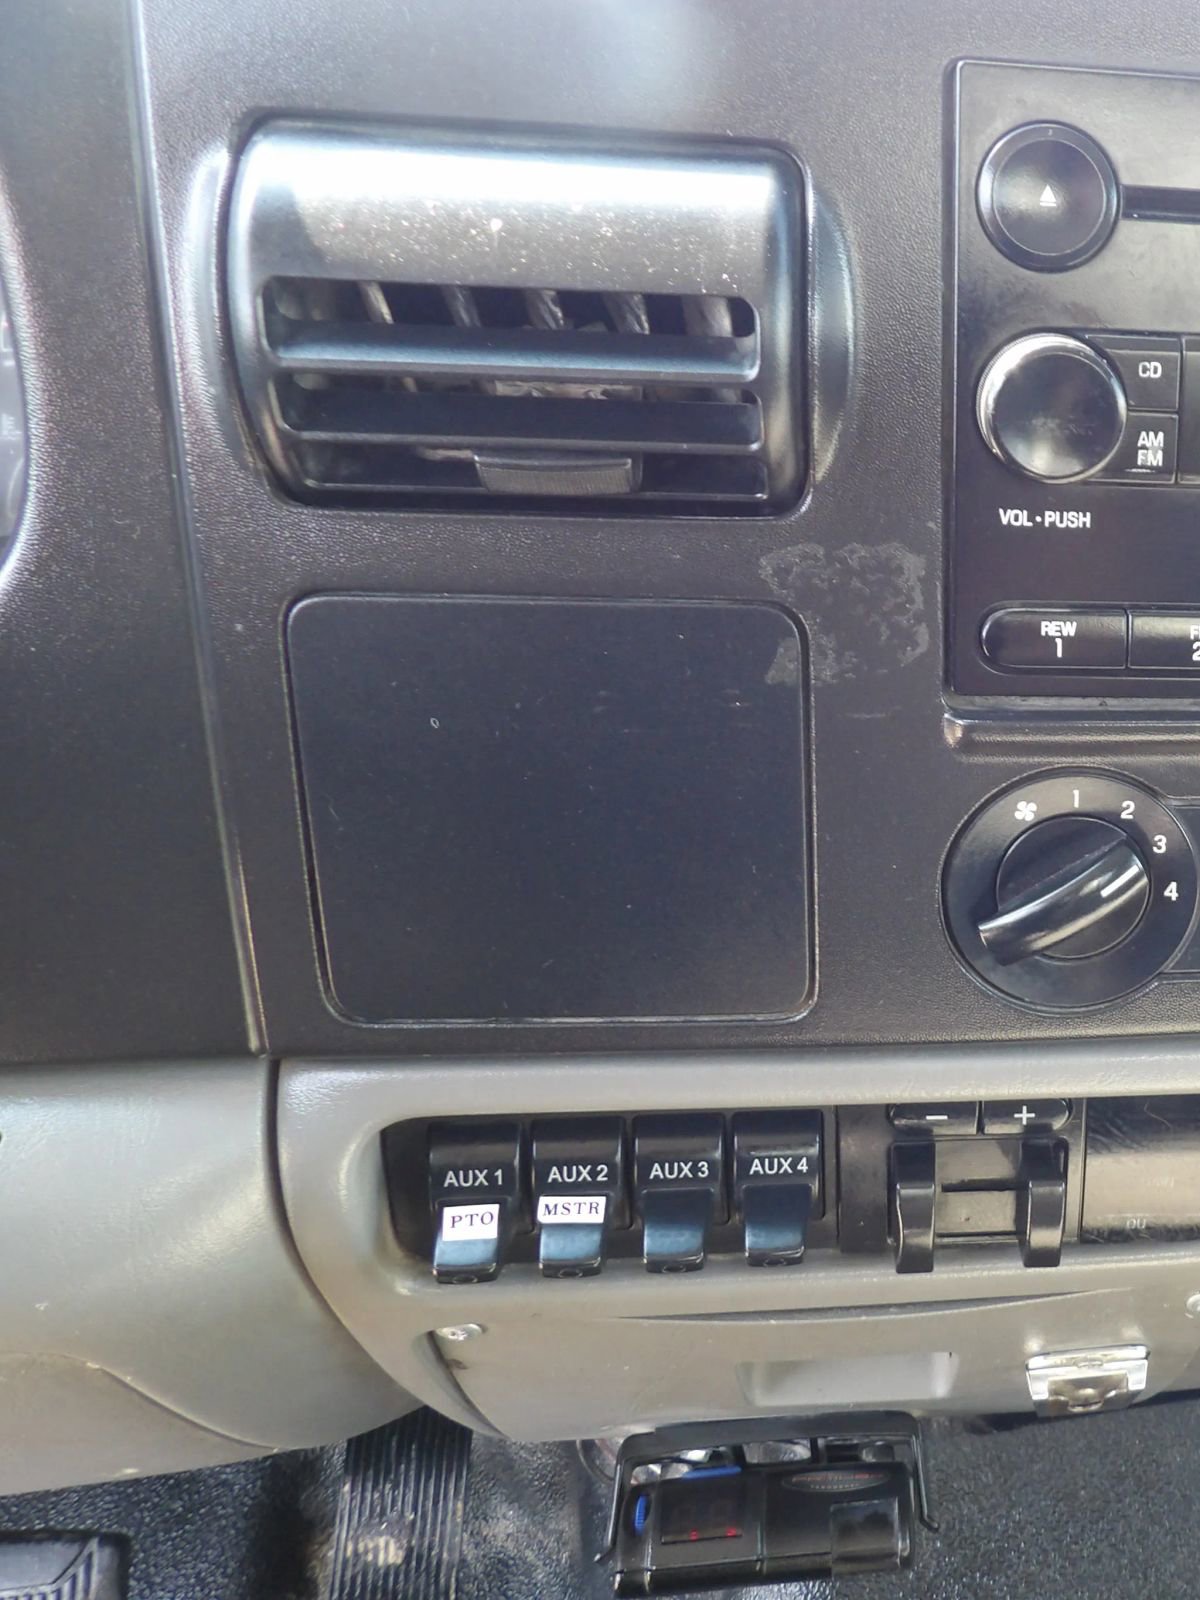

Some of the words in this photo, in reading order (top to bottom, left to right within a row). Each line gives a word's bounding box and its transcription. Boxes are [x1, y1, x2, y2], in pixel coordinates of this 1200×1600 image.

[1138, 362, 1162, 378] CD
[1137, 432, 1164, 447] AM
[1137, 450, 1163, 467] FM
[1040, 621, 1077, 637] REW
[1054, 638, 1063, 658] 1
[1072, 789, 1080, 808] 1
[1120, 800, 1135, 819] 2
[1152, 835, 1167, 853] 3
[1163, 881, 1179, 901] 4
[547, 1165, 591, 1183] AUX
[596, 1164, 608, 1181] 2
[649, 1161, 693, 1179] AUX
[697, 1161, 709, 1178] 3
[749, 1157, 793, 1175] AUX
[796, 1157, 808, 1174] 4
[443, 1169, 490, 1188] AUX
[494, 1169, 504, 1186] 1
[542, 1202, 600, 1217] MSTR
[450, 1212, 494, 1228] PTO
